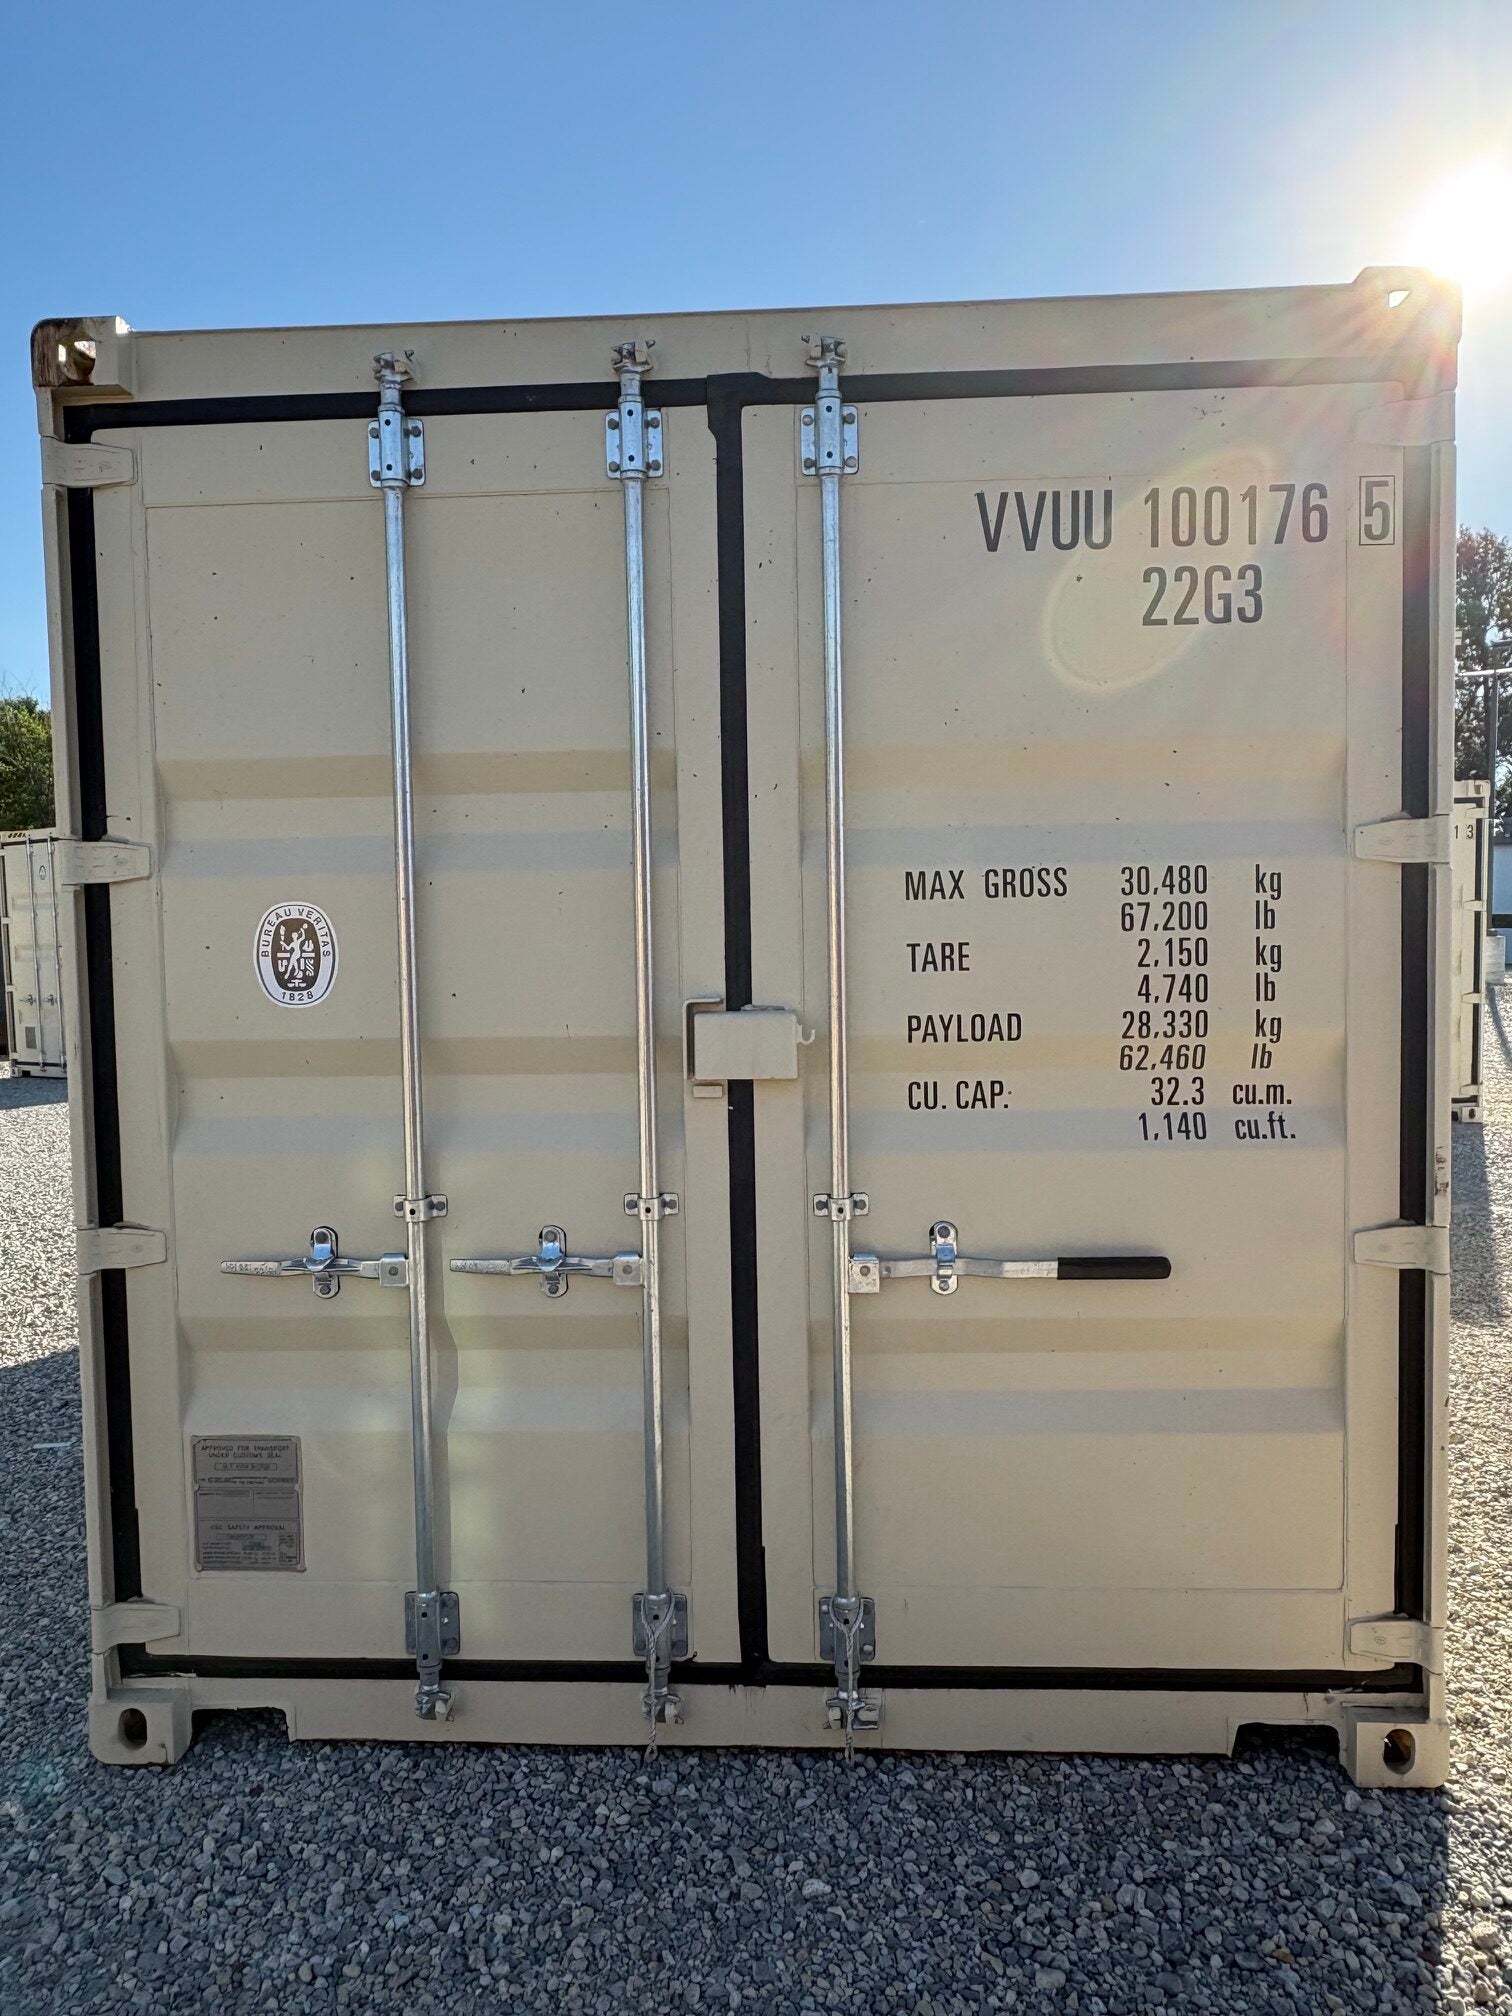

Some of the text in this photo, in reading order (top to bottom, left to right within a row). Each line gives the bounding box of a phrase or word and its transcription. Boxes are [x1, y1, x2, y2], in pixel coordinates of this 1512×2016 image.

[973, 480, 1389, 553] VVUU 100176 5
[1142, 564, 1263, 627] 22G3
[905, 864, 1282, 900] MAX GROSS 30,480 kg
[261, 908, 331, 957] BUREAU VERITAS
[1120, 900, 1276, 932] 67,200 lb
[906, 936, 1282, 973] TARE 2,150 kg
[281, 991, 314, 1002] 1828
[1138, 973, 1276, 1004] 4,740 lb
[907, 1009, 1282, 1043] PAYLOAD 28,330 kg
[1119, 1043, 1273, 1071] 62,460 lb
[908, 1081, 947, 1110] CU.
[1151, 1077, 1205, 1106] 32.3
[1232, 1083, 1293, 1105] cu.m.
[1138, 1111, 1297, 1142] 1,140 cu.ft.
